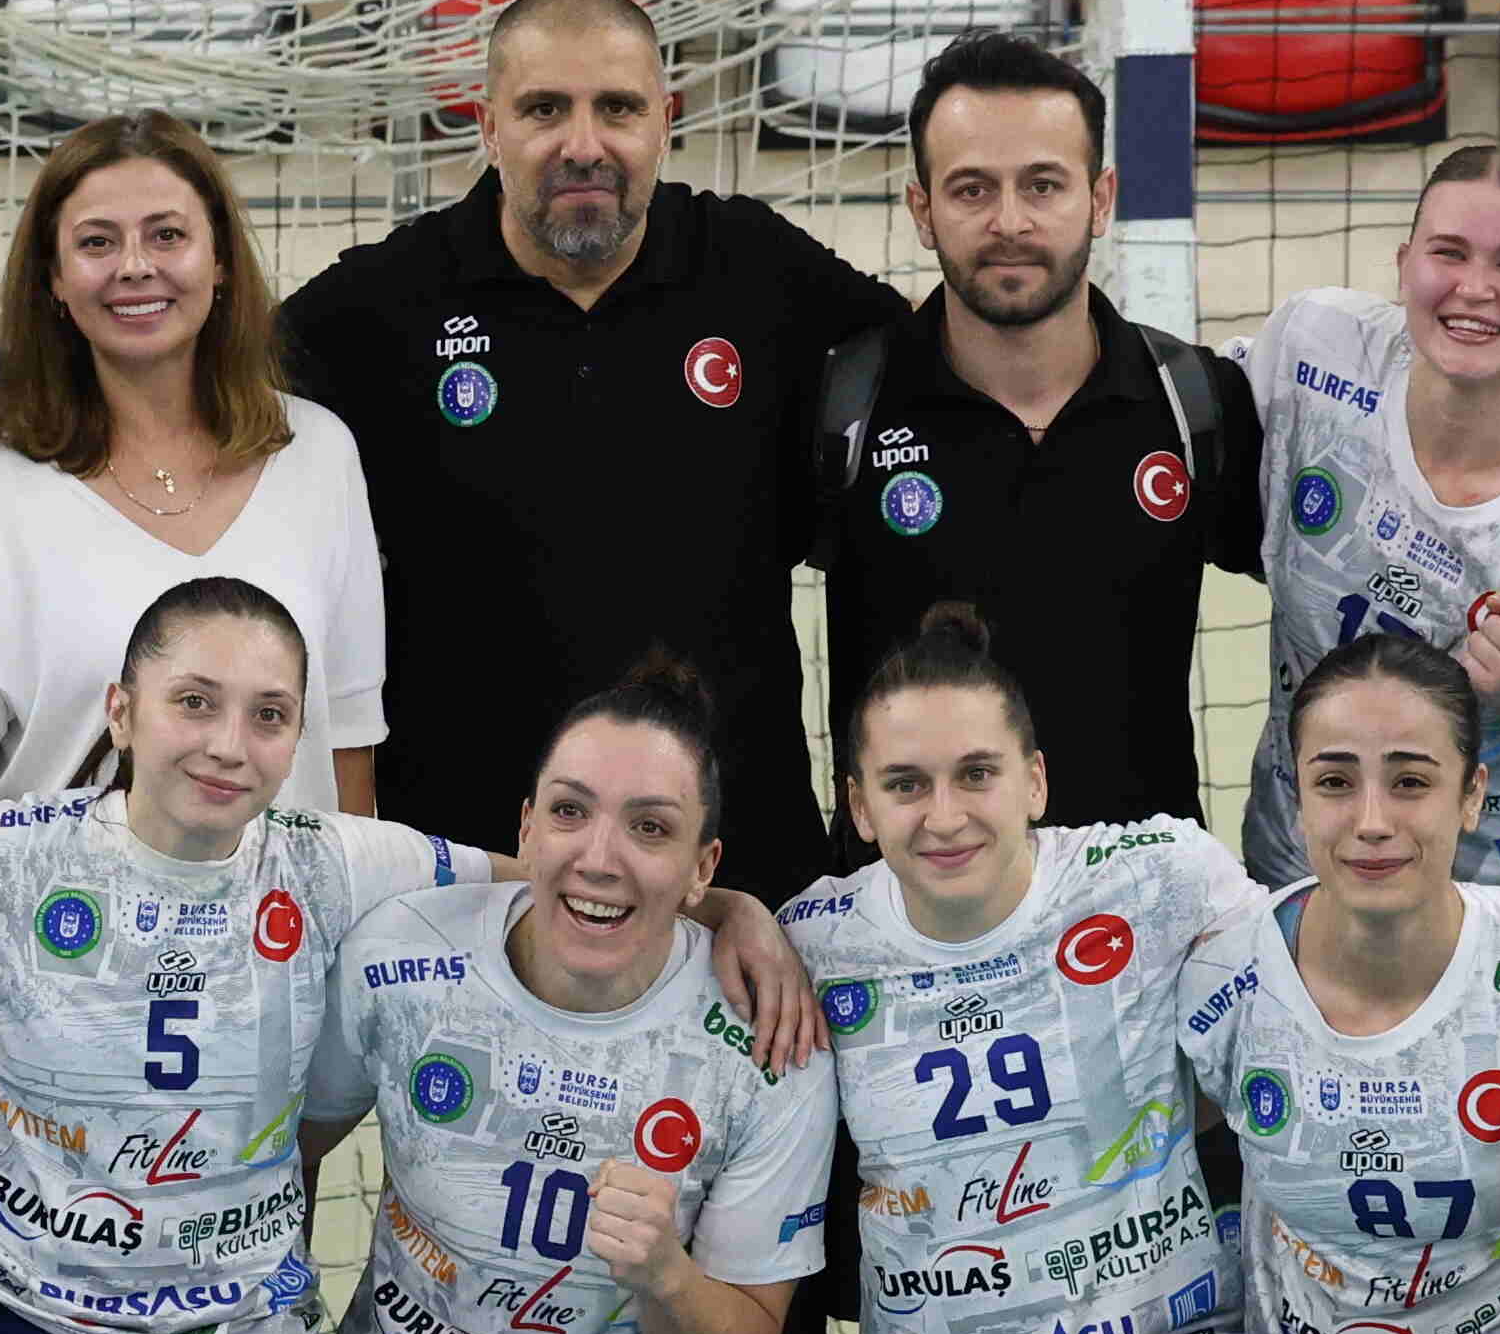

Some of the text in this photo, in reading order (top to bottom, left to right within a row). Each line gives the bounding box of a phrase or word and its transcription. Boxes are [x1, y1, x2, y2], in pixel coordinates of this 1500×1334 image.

[436, 336, 490, 360] upon
[1296, 360, 1382, 417] BURFAŞ
[872, 441, 929, 470] upon
[1367, 572, 1423, 617] upon
[146, 970, 206, 997] upon
[364, 955, 467, 989] BURFAŞ
[1188, 964, 1260, 1035] BURFAŞ
[144, 1000, 200, 1091] 5
[939, 1009, 1003, 1043] upon
[562, 1069, 619, 1092] BURSA
[914, 1032, 1053, 1141] 29
[1359, 1080, 1421, 1095] BURSA
[1360, 1103, 1423, 1116] BELEDİYESİ
[108, 1108, 210, 1185] FitLine
[525, 1131, 586, 1162] upon
[1340, 1150, 1404, 1177] upon
[958, 1141, 1053, 1224] FitLine
[501, 1160, 591, 1261] 10
[1089, 1185, 1204, 1264] BURSA
[1347, 1178, 1477, 1240] 87
[216, 1219, 283, 1259] KÜLTÜR
[1096, 1242, 1174, 1286] KÜLTÜR
